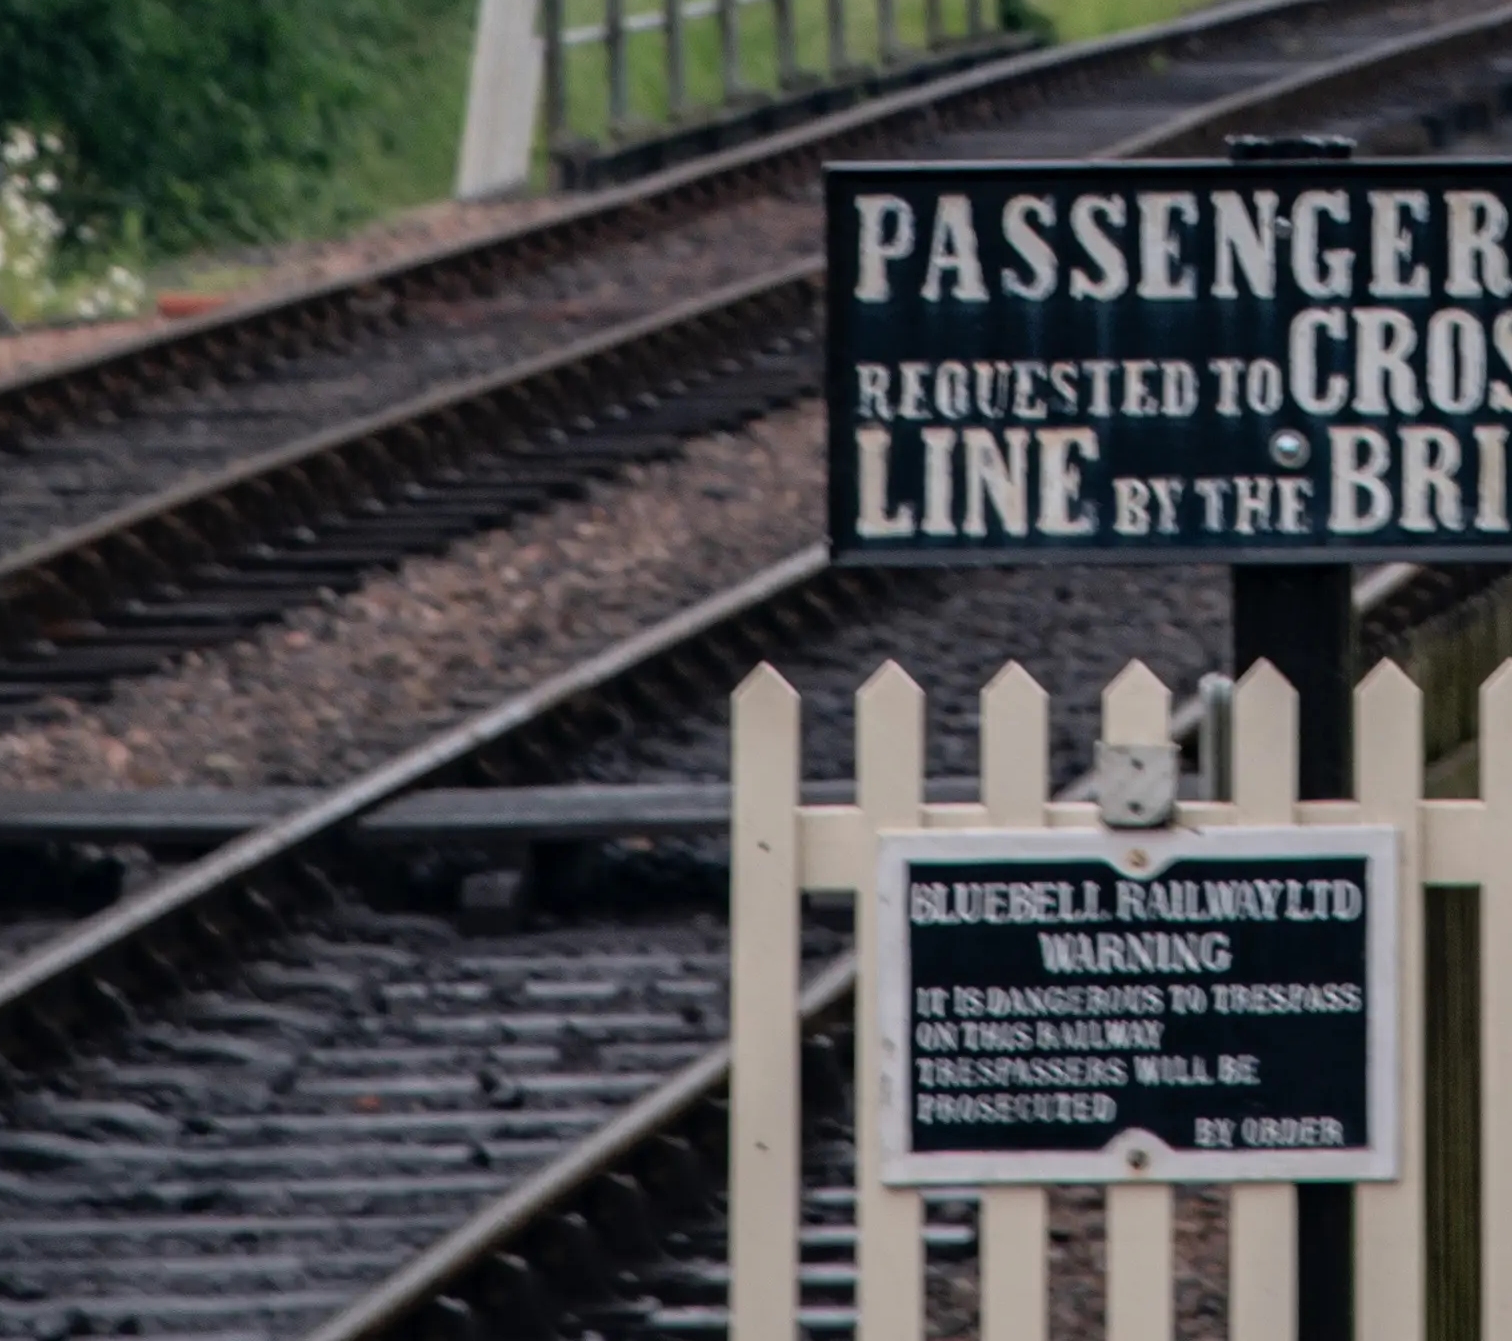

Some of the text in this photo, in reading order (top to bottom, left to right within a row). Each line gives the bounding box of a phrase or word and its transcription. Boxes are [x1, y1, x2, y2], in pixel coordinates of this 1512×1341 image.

[855, 359, 1200, 421] REQUESTED
[1208, 358, 1284, 418] TO
[854, 426, 1100, 538] LINE
[1112, 476, 1183, 536] BY
[1193, 475, 1315, 535] THE
[909, 879, 1363, 925] BLUEBELL RAILWAY LTD
[1036, 931, 1233, 974] WARNING
[916, 983, 1364, 1017] IT IS DANGEROUS TO TRESPASS
[915, 1019, 1166, 1051] ON THIS RAILWAY
[915, 1055, 1262, 1087] TRESPASSERS WILL BE
[916, 1093, 1118, 1124] PROSECUTED
[1193, 1117, 1346, 1148] BY ORDER
